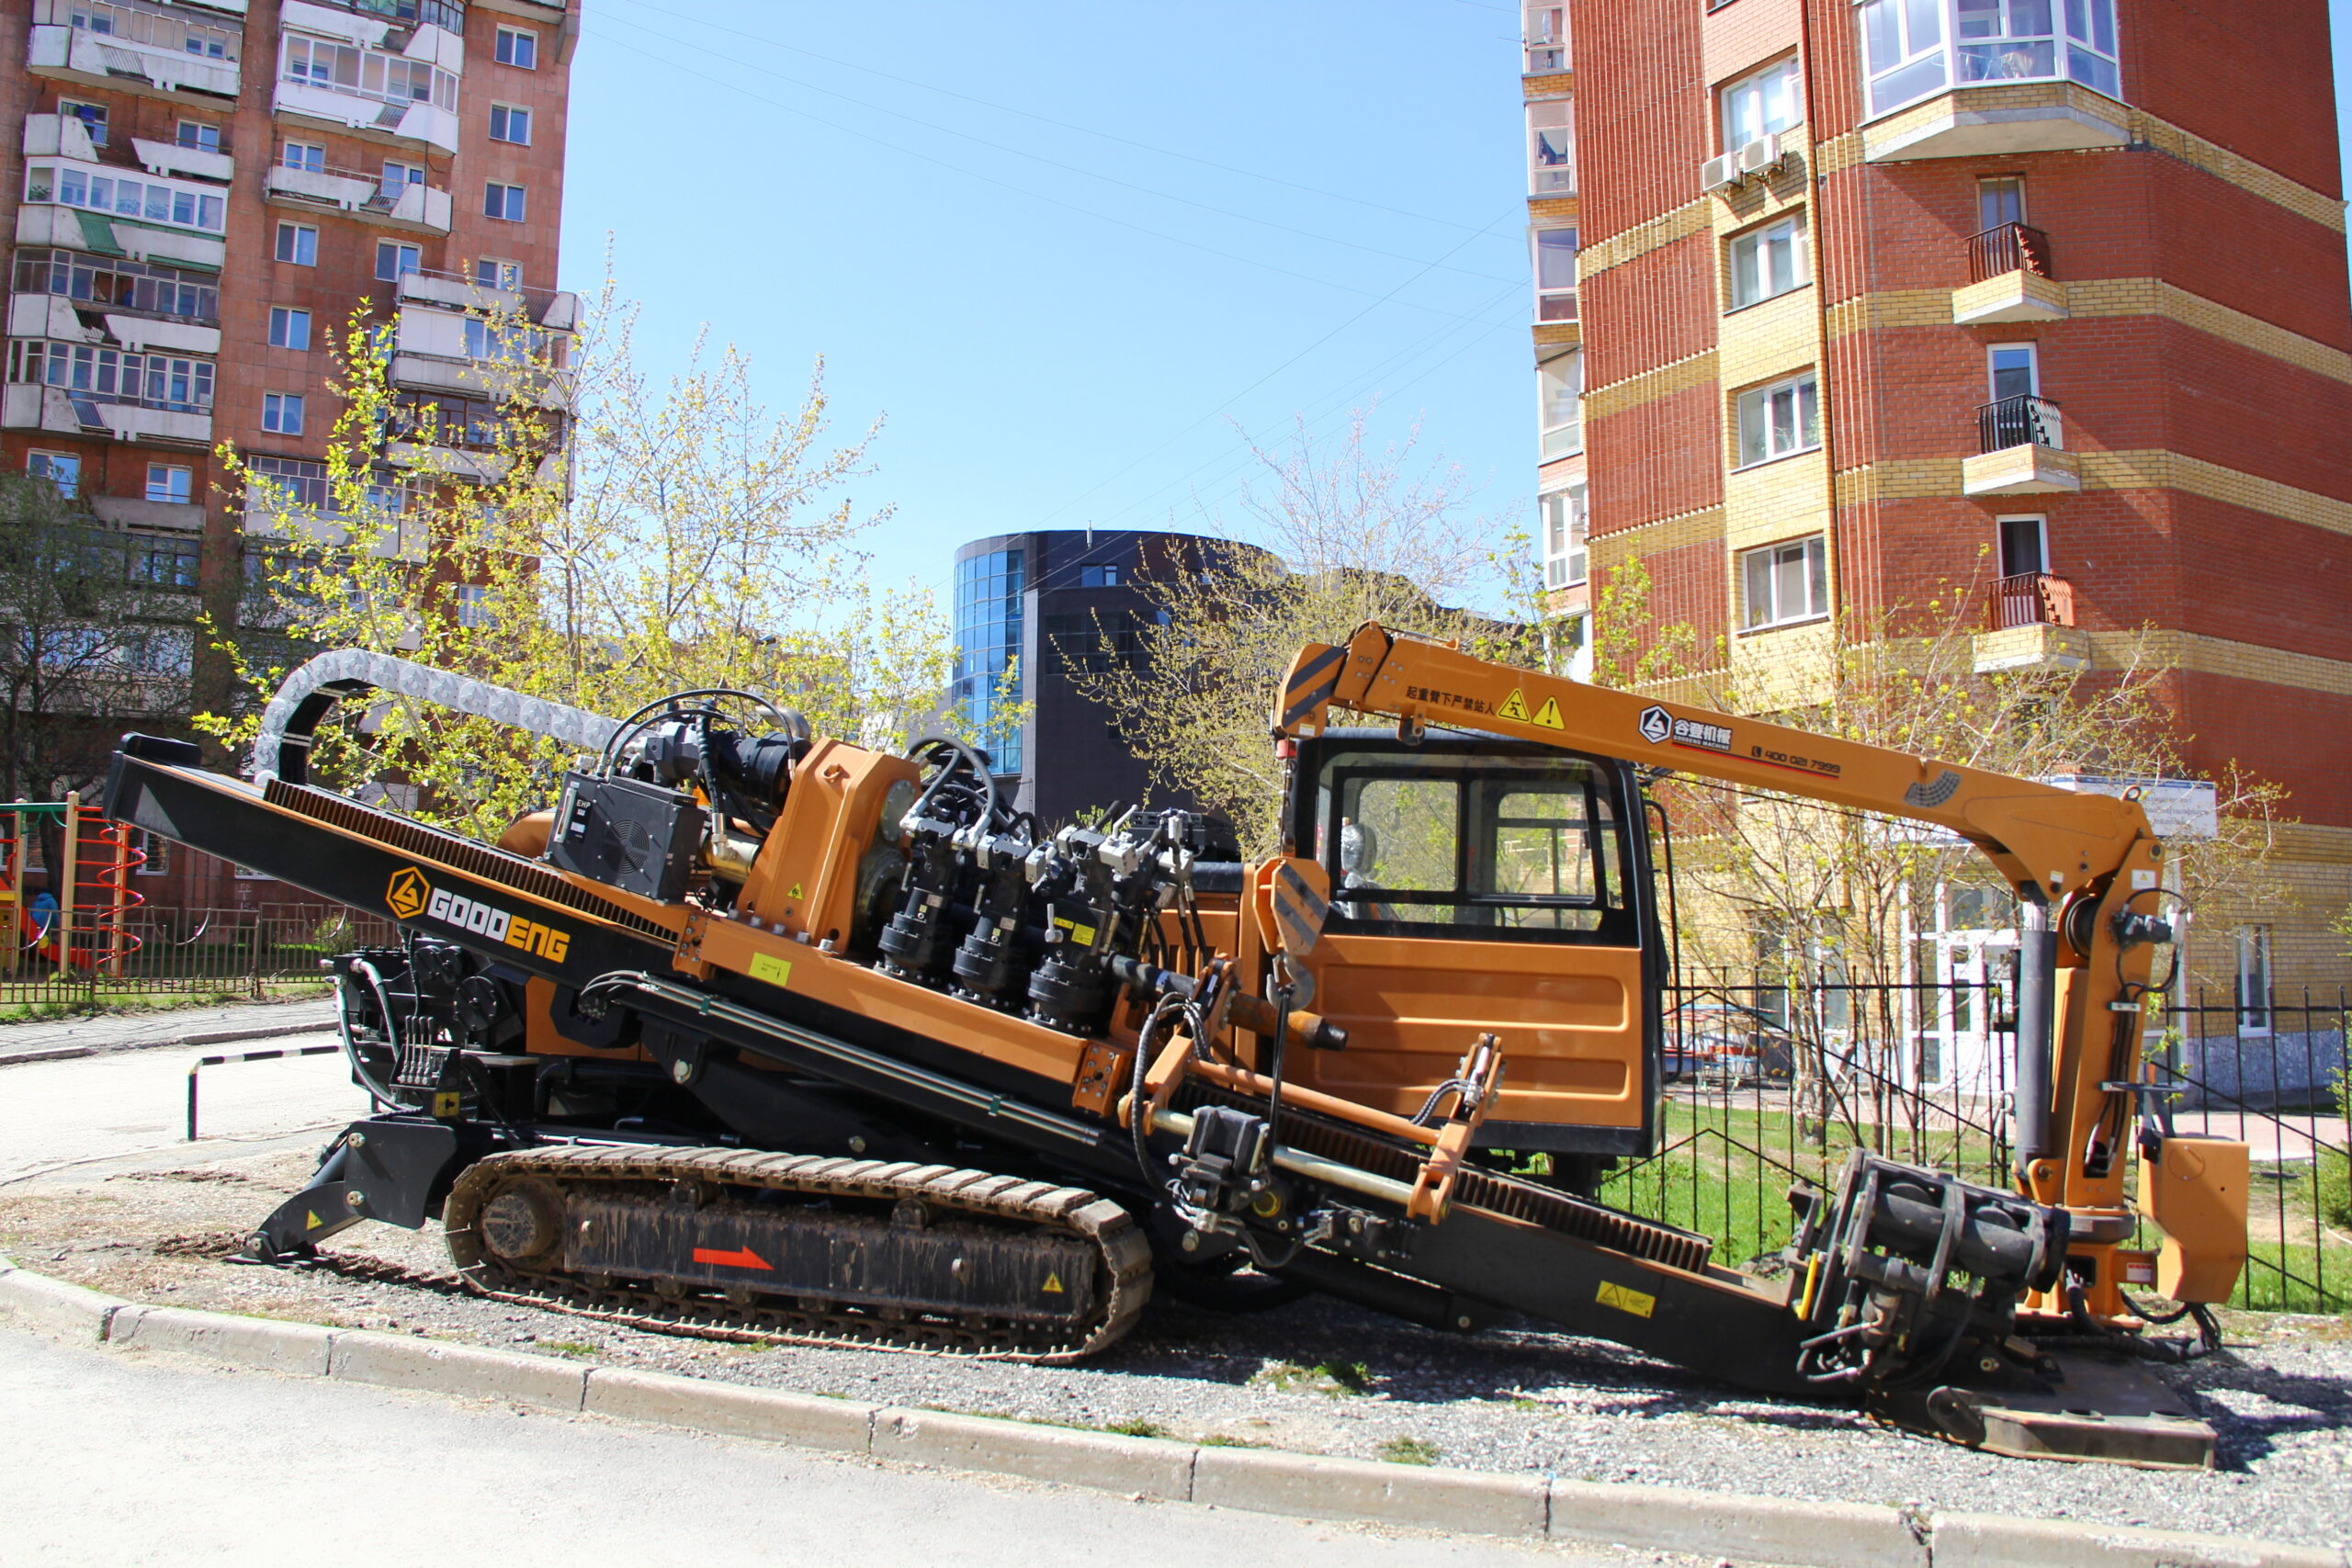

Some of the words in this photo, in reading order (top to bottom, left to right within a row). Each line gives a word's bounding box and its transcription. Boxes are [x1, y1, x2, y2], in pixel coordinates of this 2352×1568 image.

[1407, 685, 1496, 716] 起重臂下严禁站人
[1765, 750, 1787, 762] 400
[1790, 755, 1808, 767] 021
[427, 887, 571, 964] GOODENG
